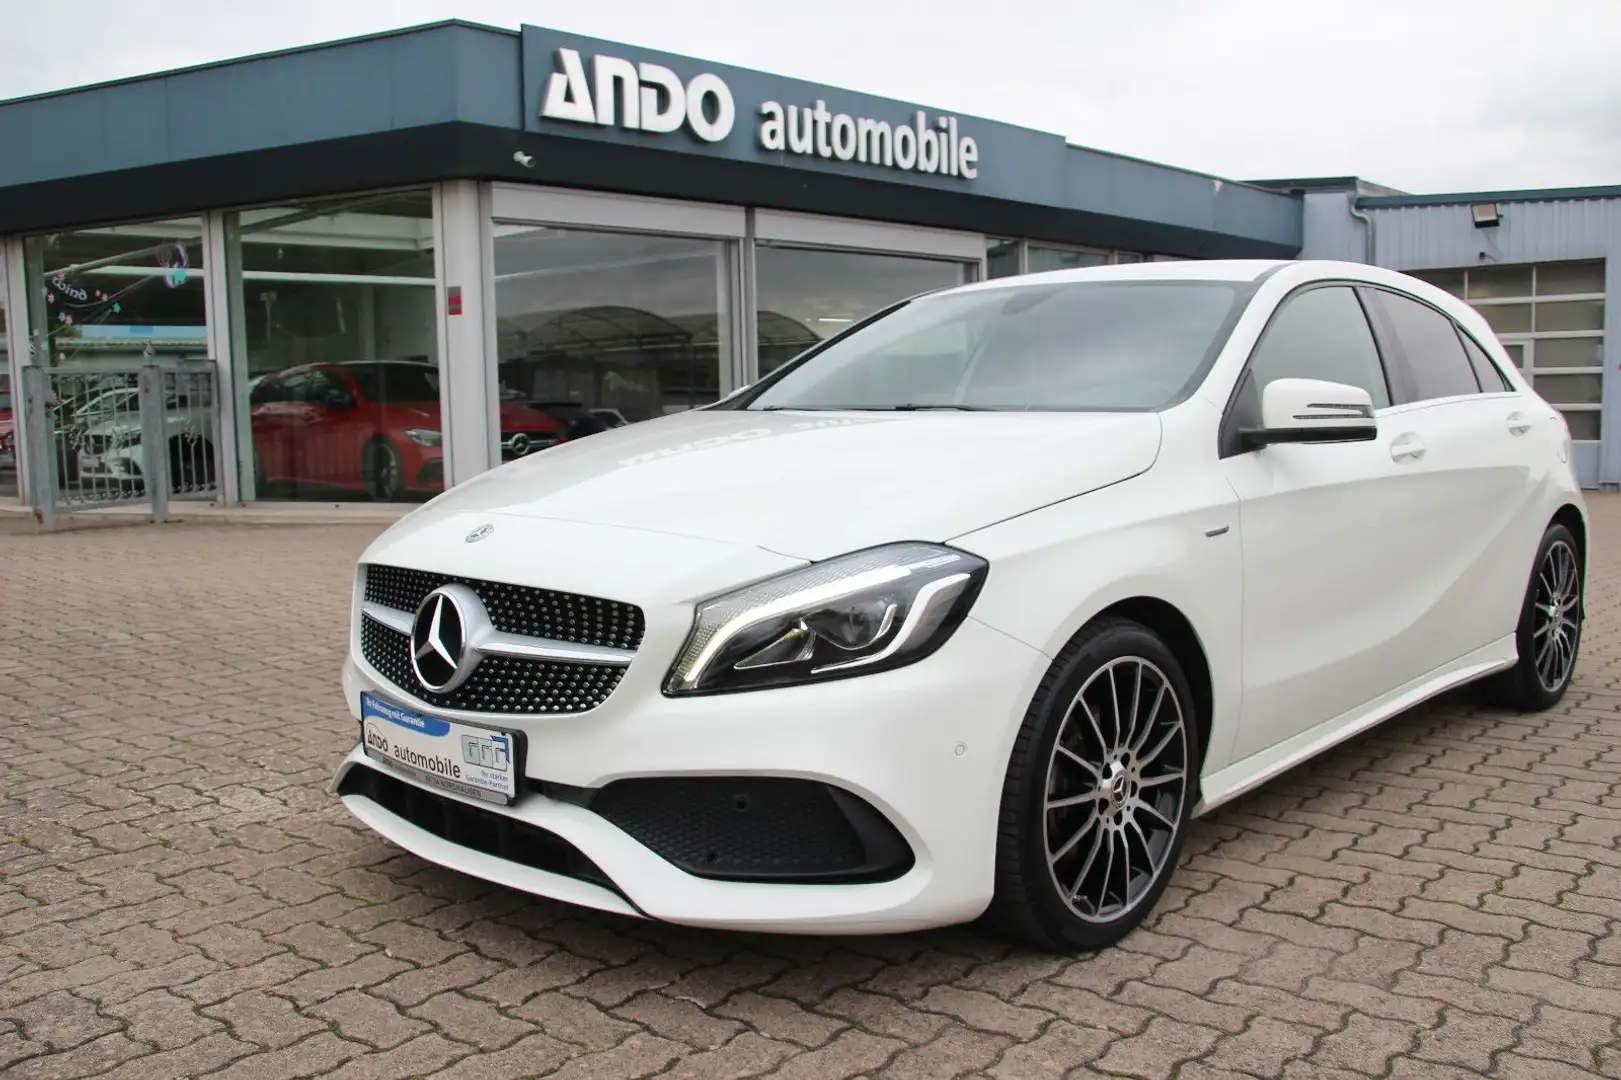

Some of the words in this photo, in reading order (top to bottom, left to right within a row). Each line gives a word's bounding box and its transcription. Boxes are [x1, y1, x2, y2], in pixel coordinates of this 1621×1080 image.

[540, 47, 736, 143] ANDO
[758, 99, 979, 181] automobile
[400, 712, 425, 728] Garantie
[393, 744, 461, 779] automobile
[465, 774, 509, 790] Garantie-Partner
[489, 772, 509, 782] starker
